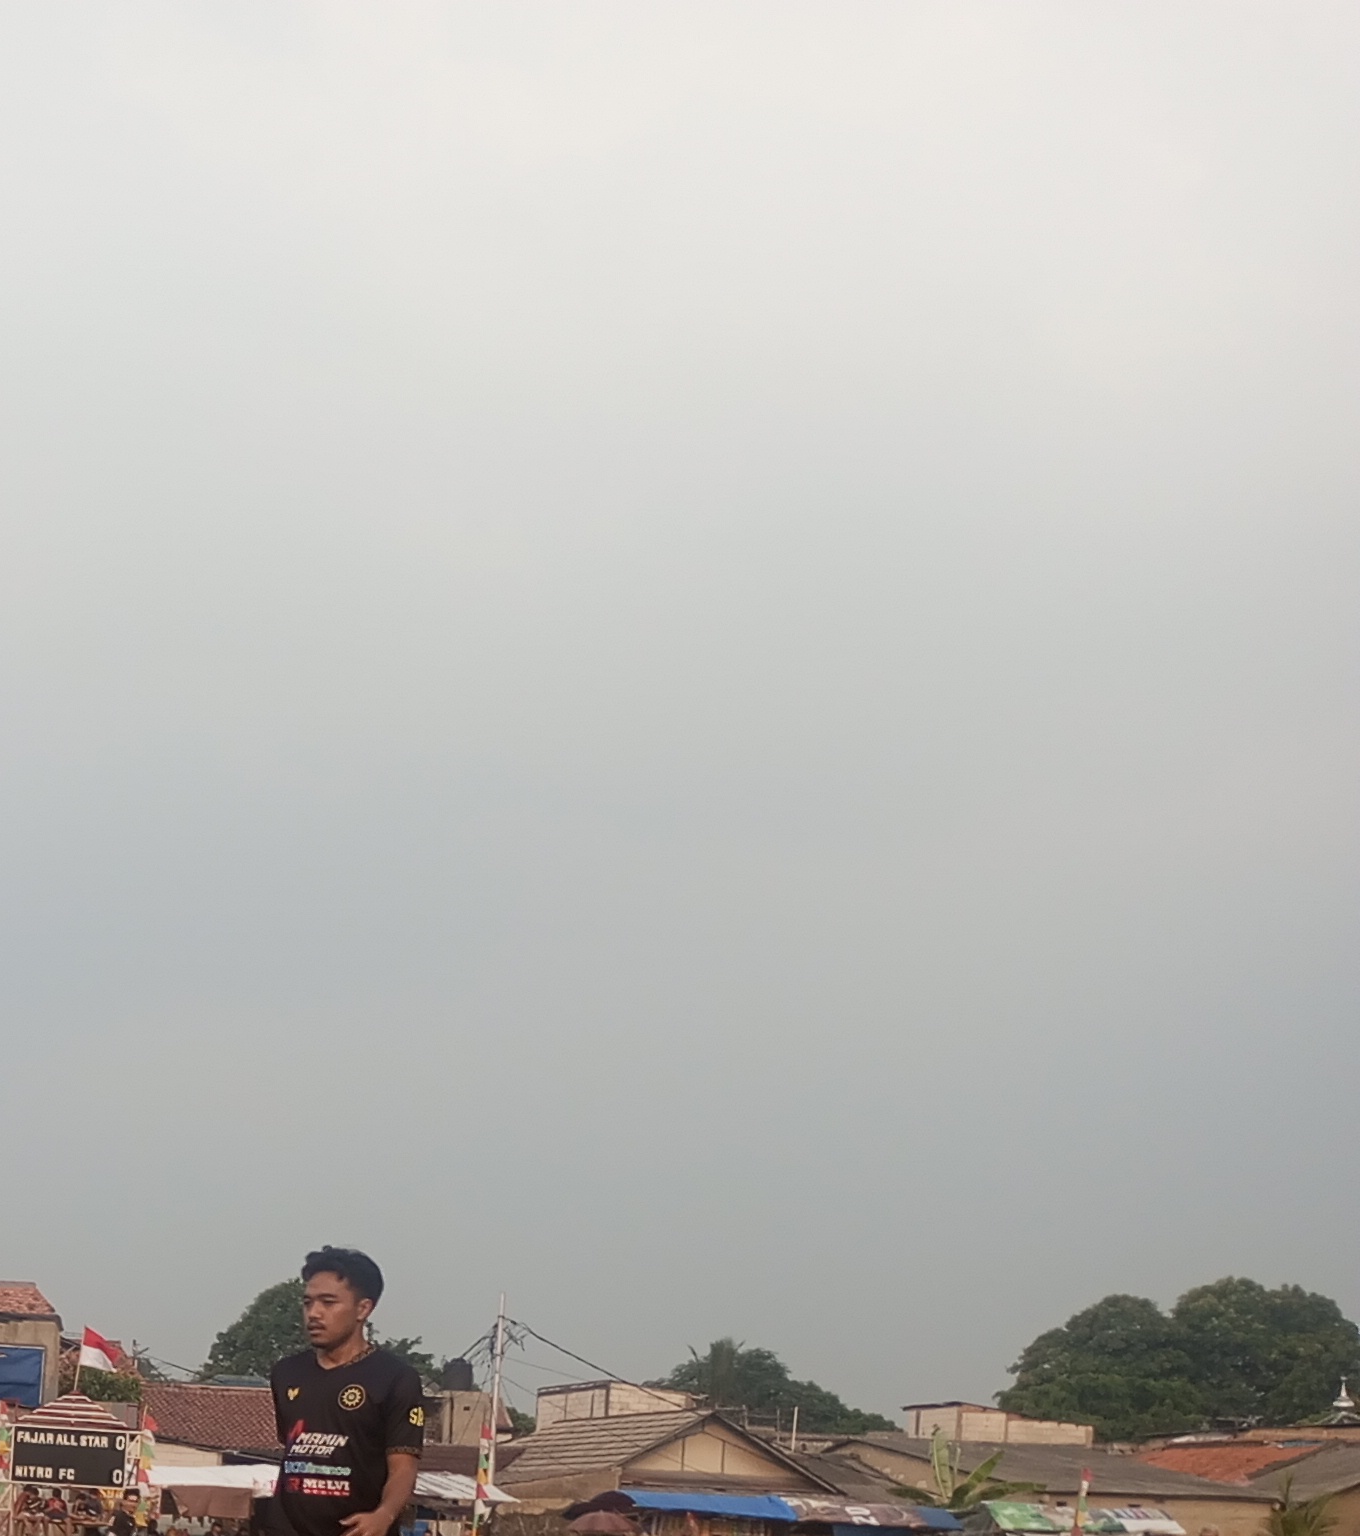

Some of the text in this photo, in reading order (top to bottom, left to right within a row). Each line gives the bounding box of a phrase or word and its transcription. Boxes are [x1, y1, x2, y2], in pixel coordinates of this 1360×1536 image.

[17, 1431, 126, 1451] FAJAR ALL STAR 0
[295, 1432, 349, 1447] MAMIN
[290, 1444, 337, 1456] MOTOR
[15, 1465, 122, 1484] NITRO FC 0
